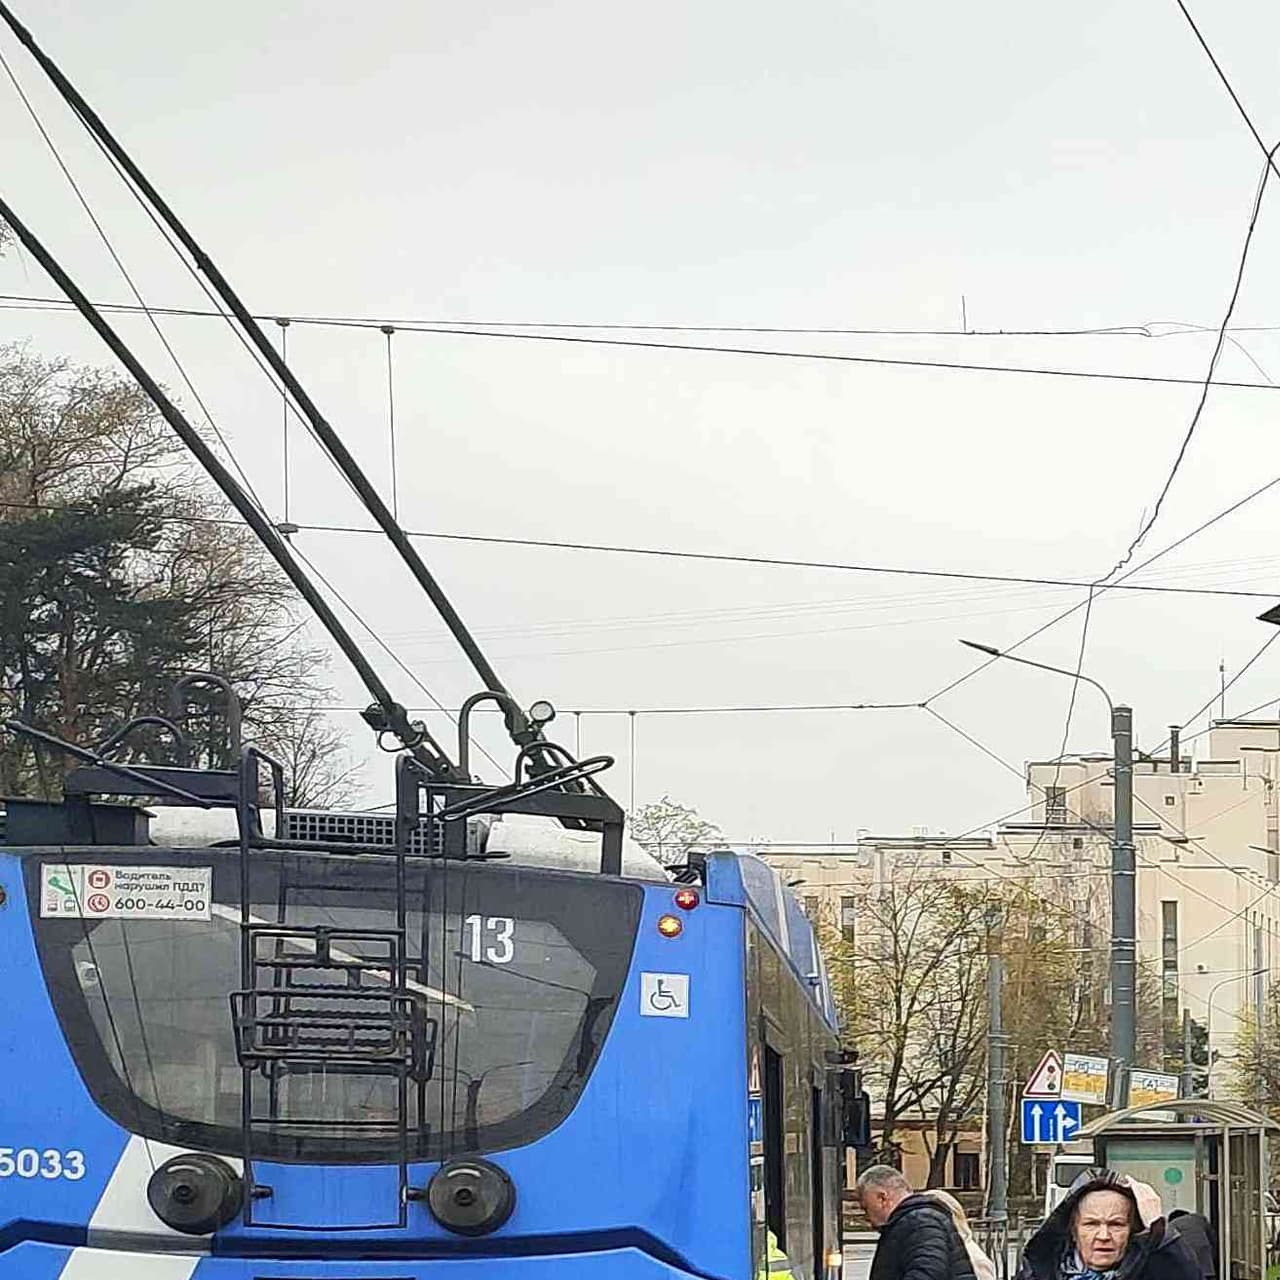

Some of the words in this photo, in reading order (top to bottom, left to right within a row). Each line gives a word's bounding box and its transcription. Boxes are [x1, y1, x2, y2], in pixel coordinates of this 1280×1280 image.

[114, 870, 172, 881] Водитель
[114, 882, 170, 893] нарушил
[172, 882, 205, 893] ПДД?
[114, 898, 205, 911] 600-44-00
[465, 914, 514, 964] 13
[0, 1147, 86, 1180] 5033
